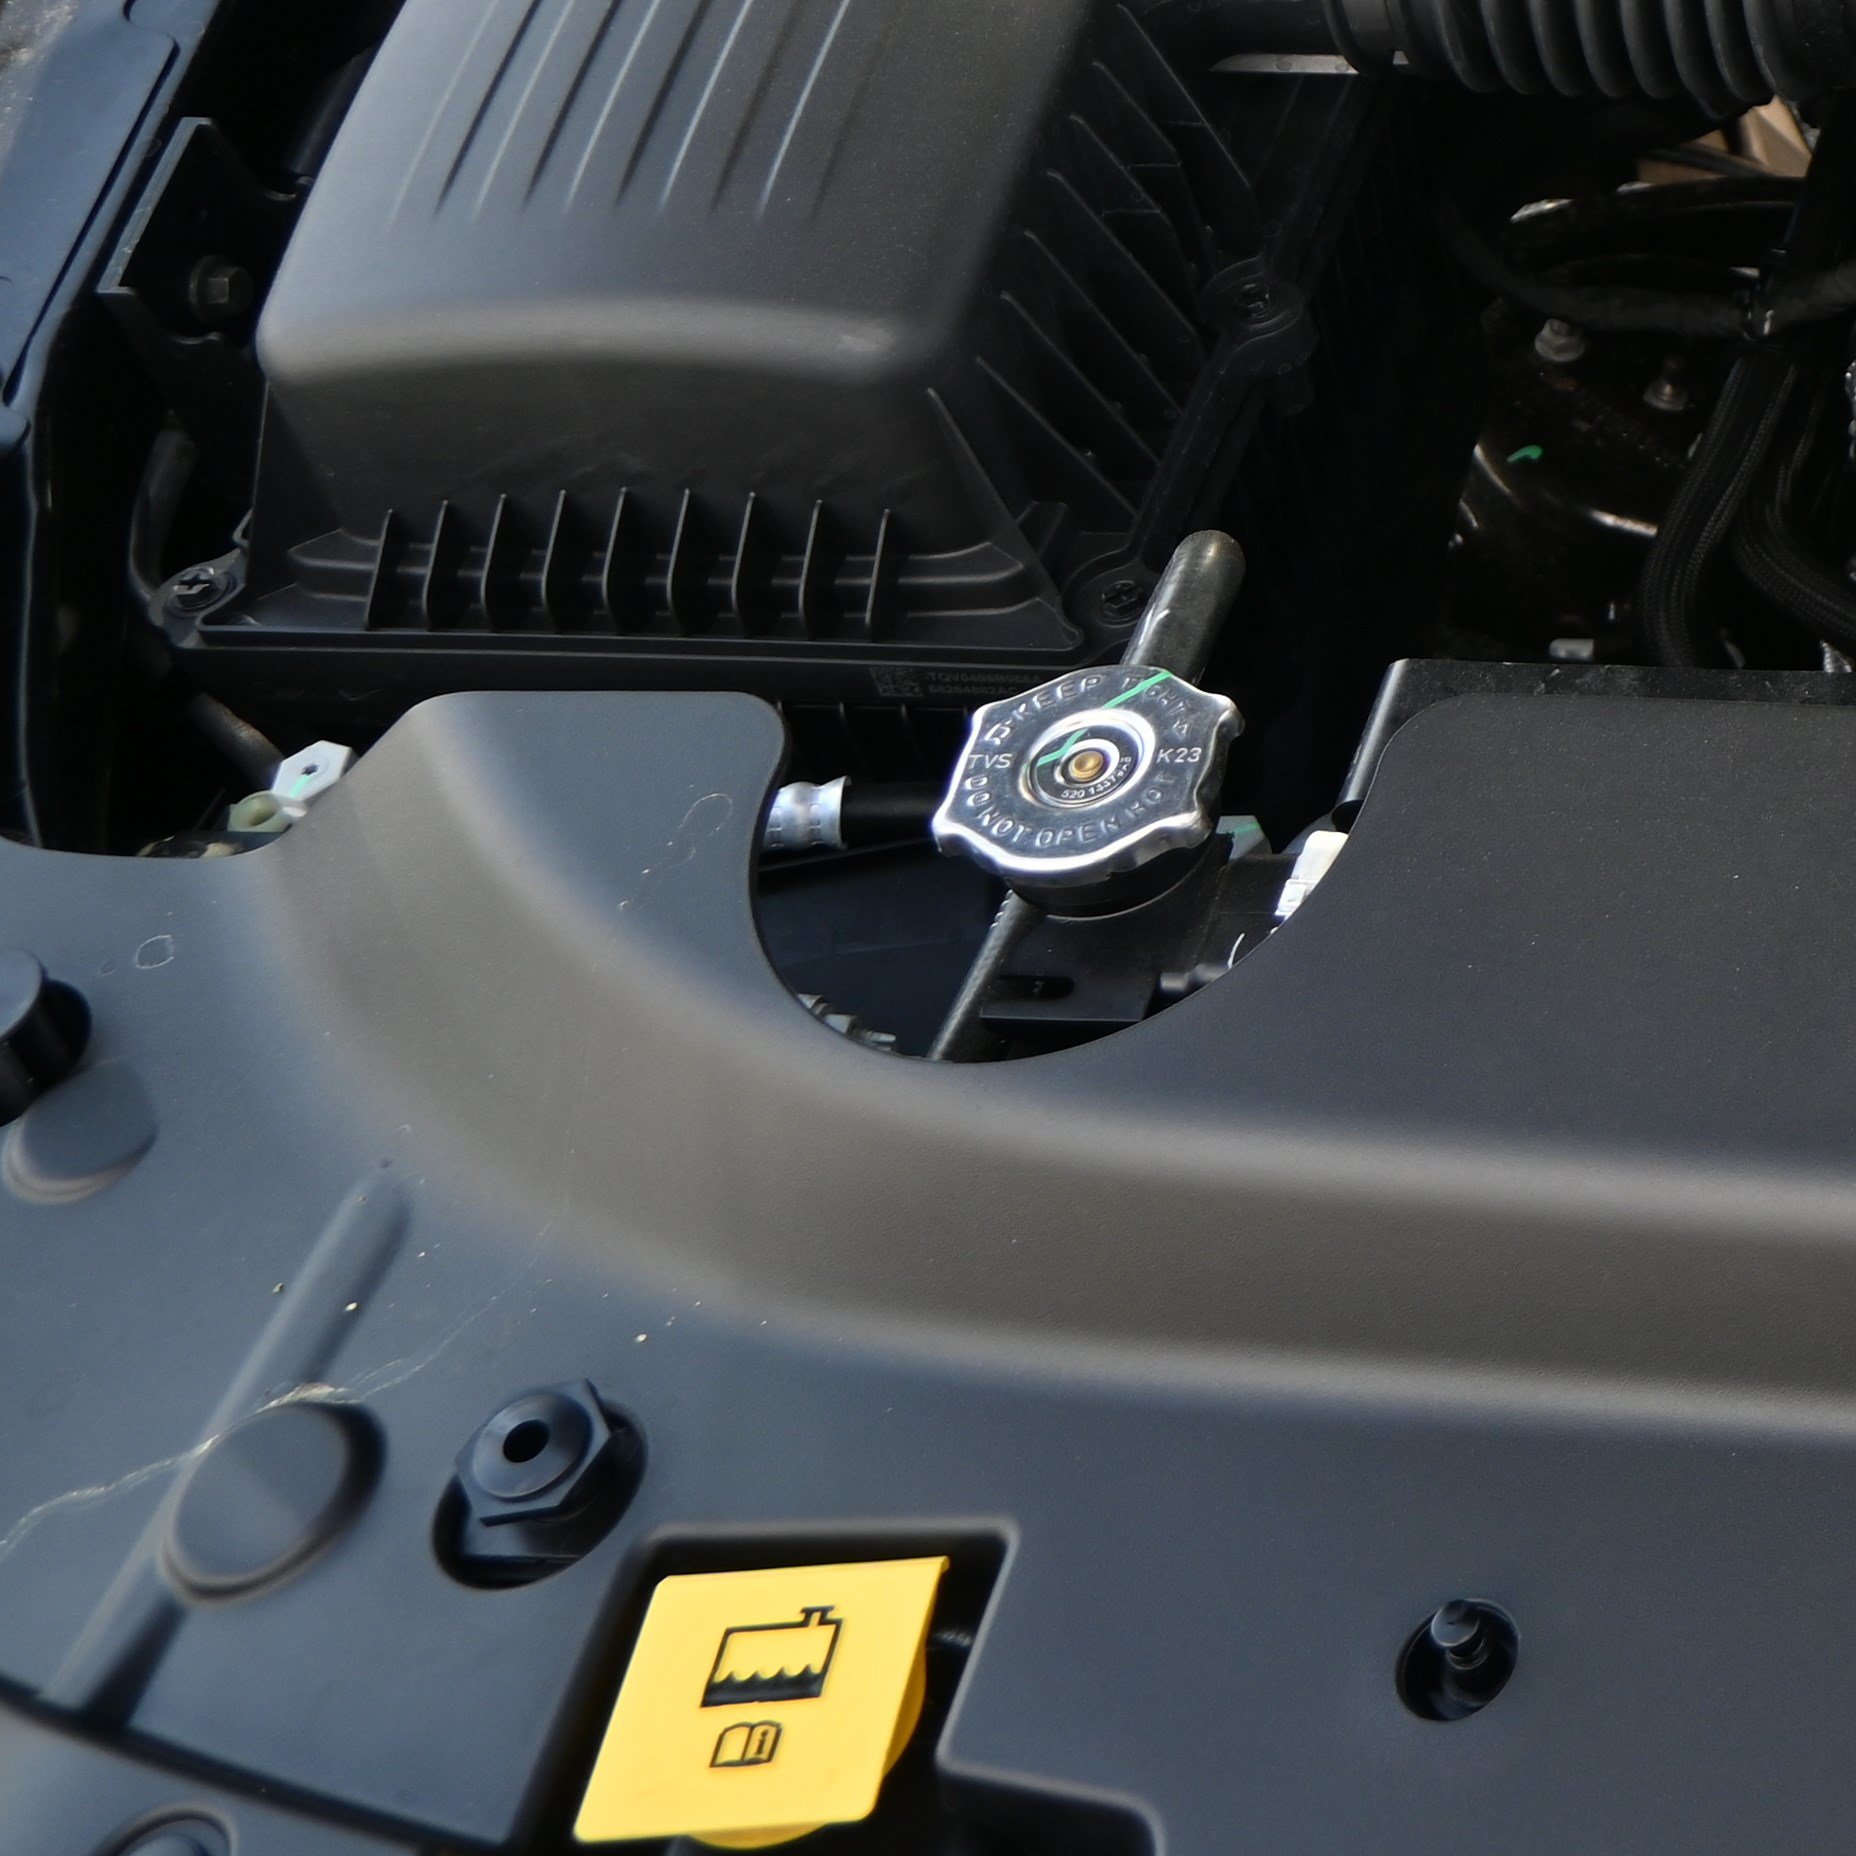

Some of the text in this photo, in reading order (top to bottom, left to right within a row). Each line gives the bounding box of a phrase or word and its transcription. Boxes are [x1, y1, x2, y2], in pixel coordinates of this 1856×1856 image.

[1012, 674, 1100, 722] KEEP
[968, 752, 1013, 770] TVS
[1156, 747, 1202, 764] K23
[975, 805, 1033, 844] NOT
[1034, 815, 1122, 850] OPEN
